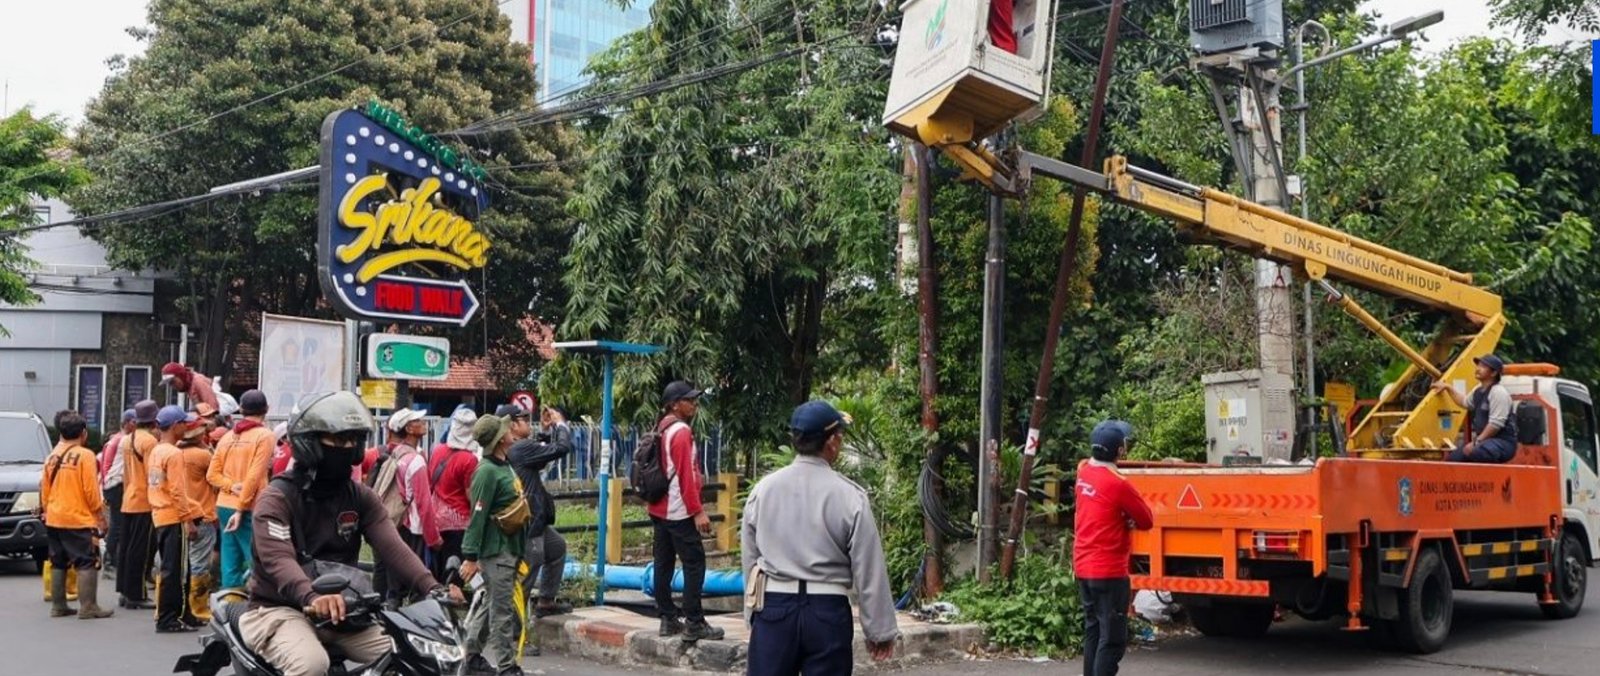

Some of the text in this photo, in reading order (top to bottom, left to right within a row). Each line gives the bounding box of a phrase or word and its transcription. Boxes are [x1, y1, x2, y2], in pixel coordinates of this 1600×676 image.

[1284, 231, 1442, 293] DINAS LINGKUNGAN HIDUP
[375, 281, 464, 315] FOOD WALK
[1420, 481, 1438, 493] DINAS
[1435, 499, 1452, 511] KOTA
